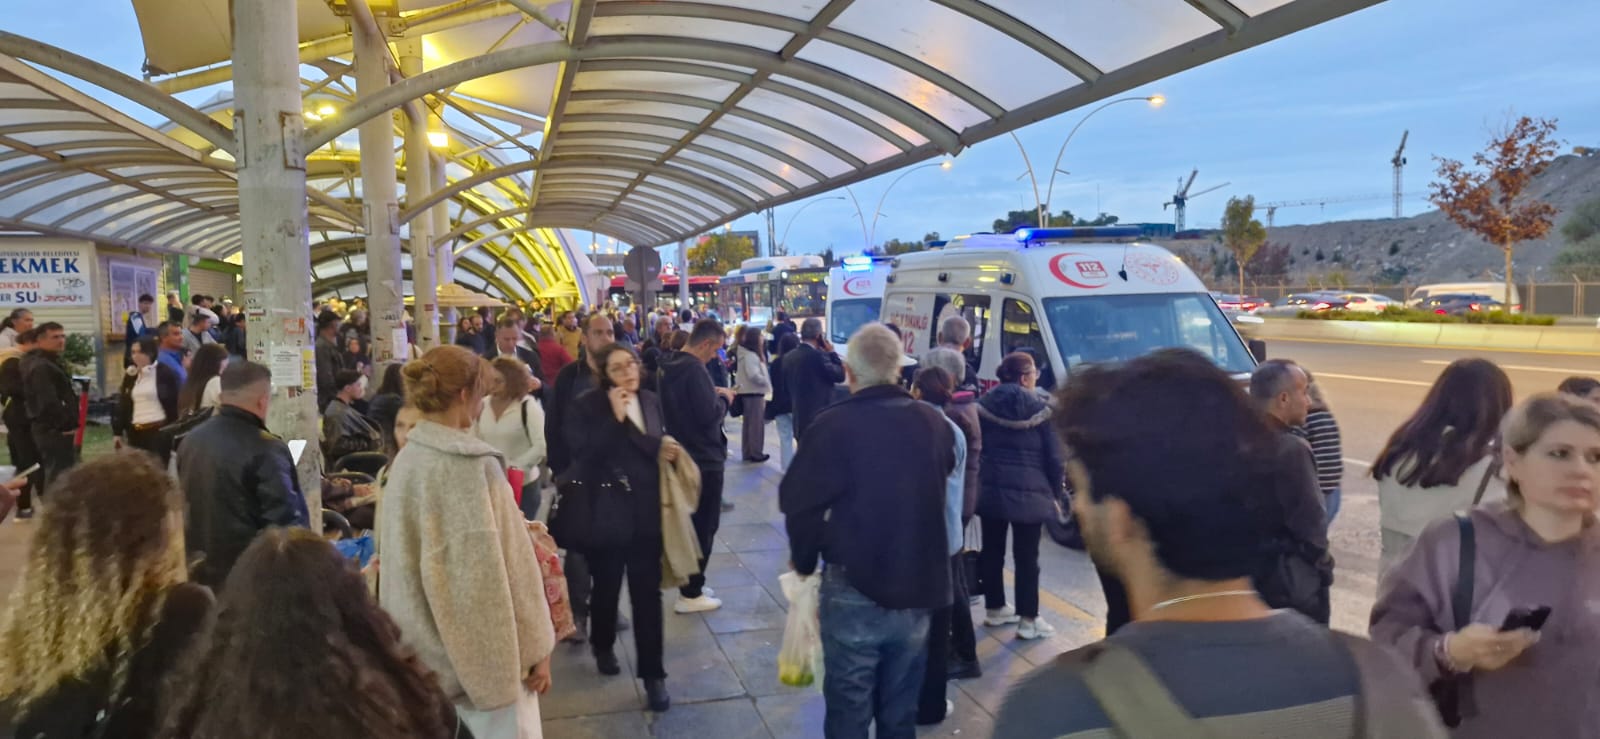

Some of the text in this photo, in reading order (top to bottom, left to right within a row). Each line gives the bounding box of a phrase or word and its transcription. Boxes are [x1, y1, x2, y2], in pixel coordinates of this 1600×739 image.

[0, 258, 79, 273] EKMEK
[1079, 262, 1102, 271] 112
[15, 291, 38, 303] SU
